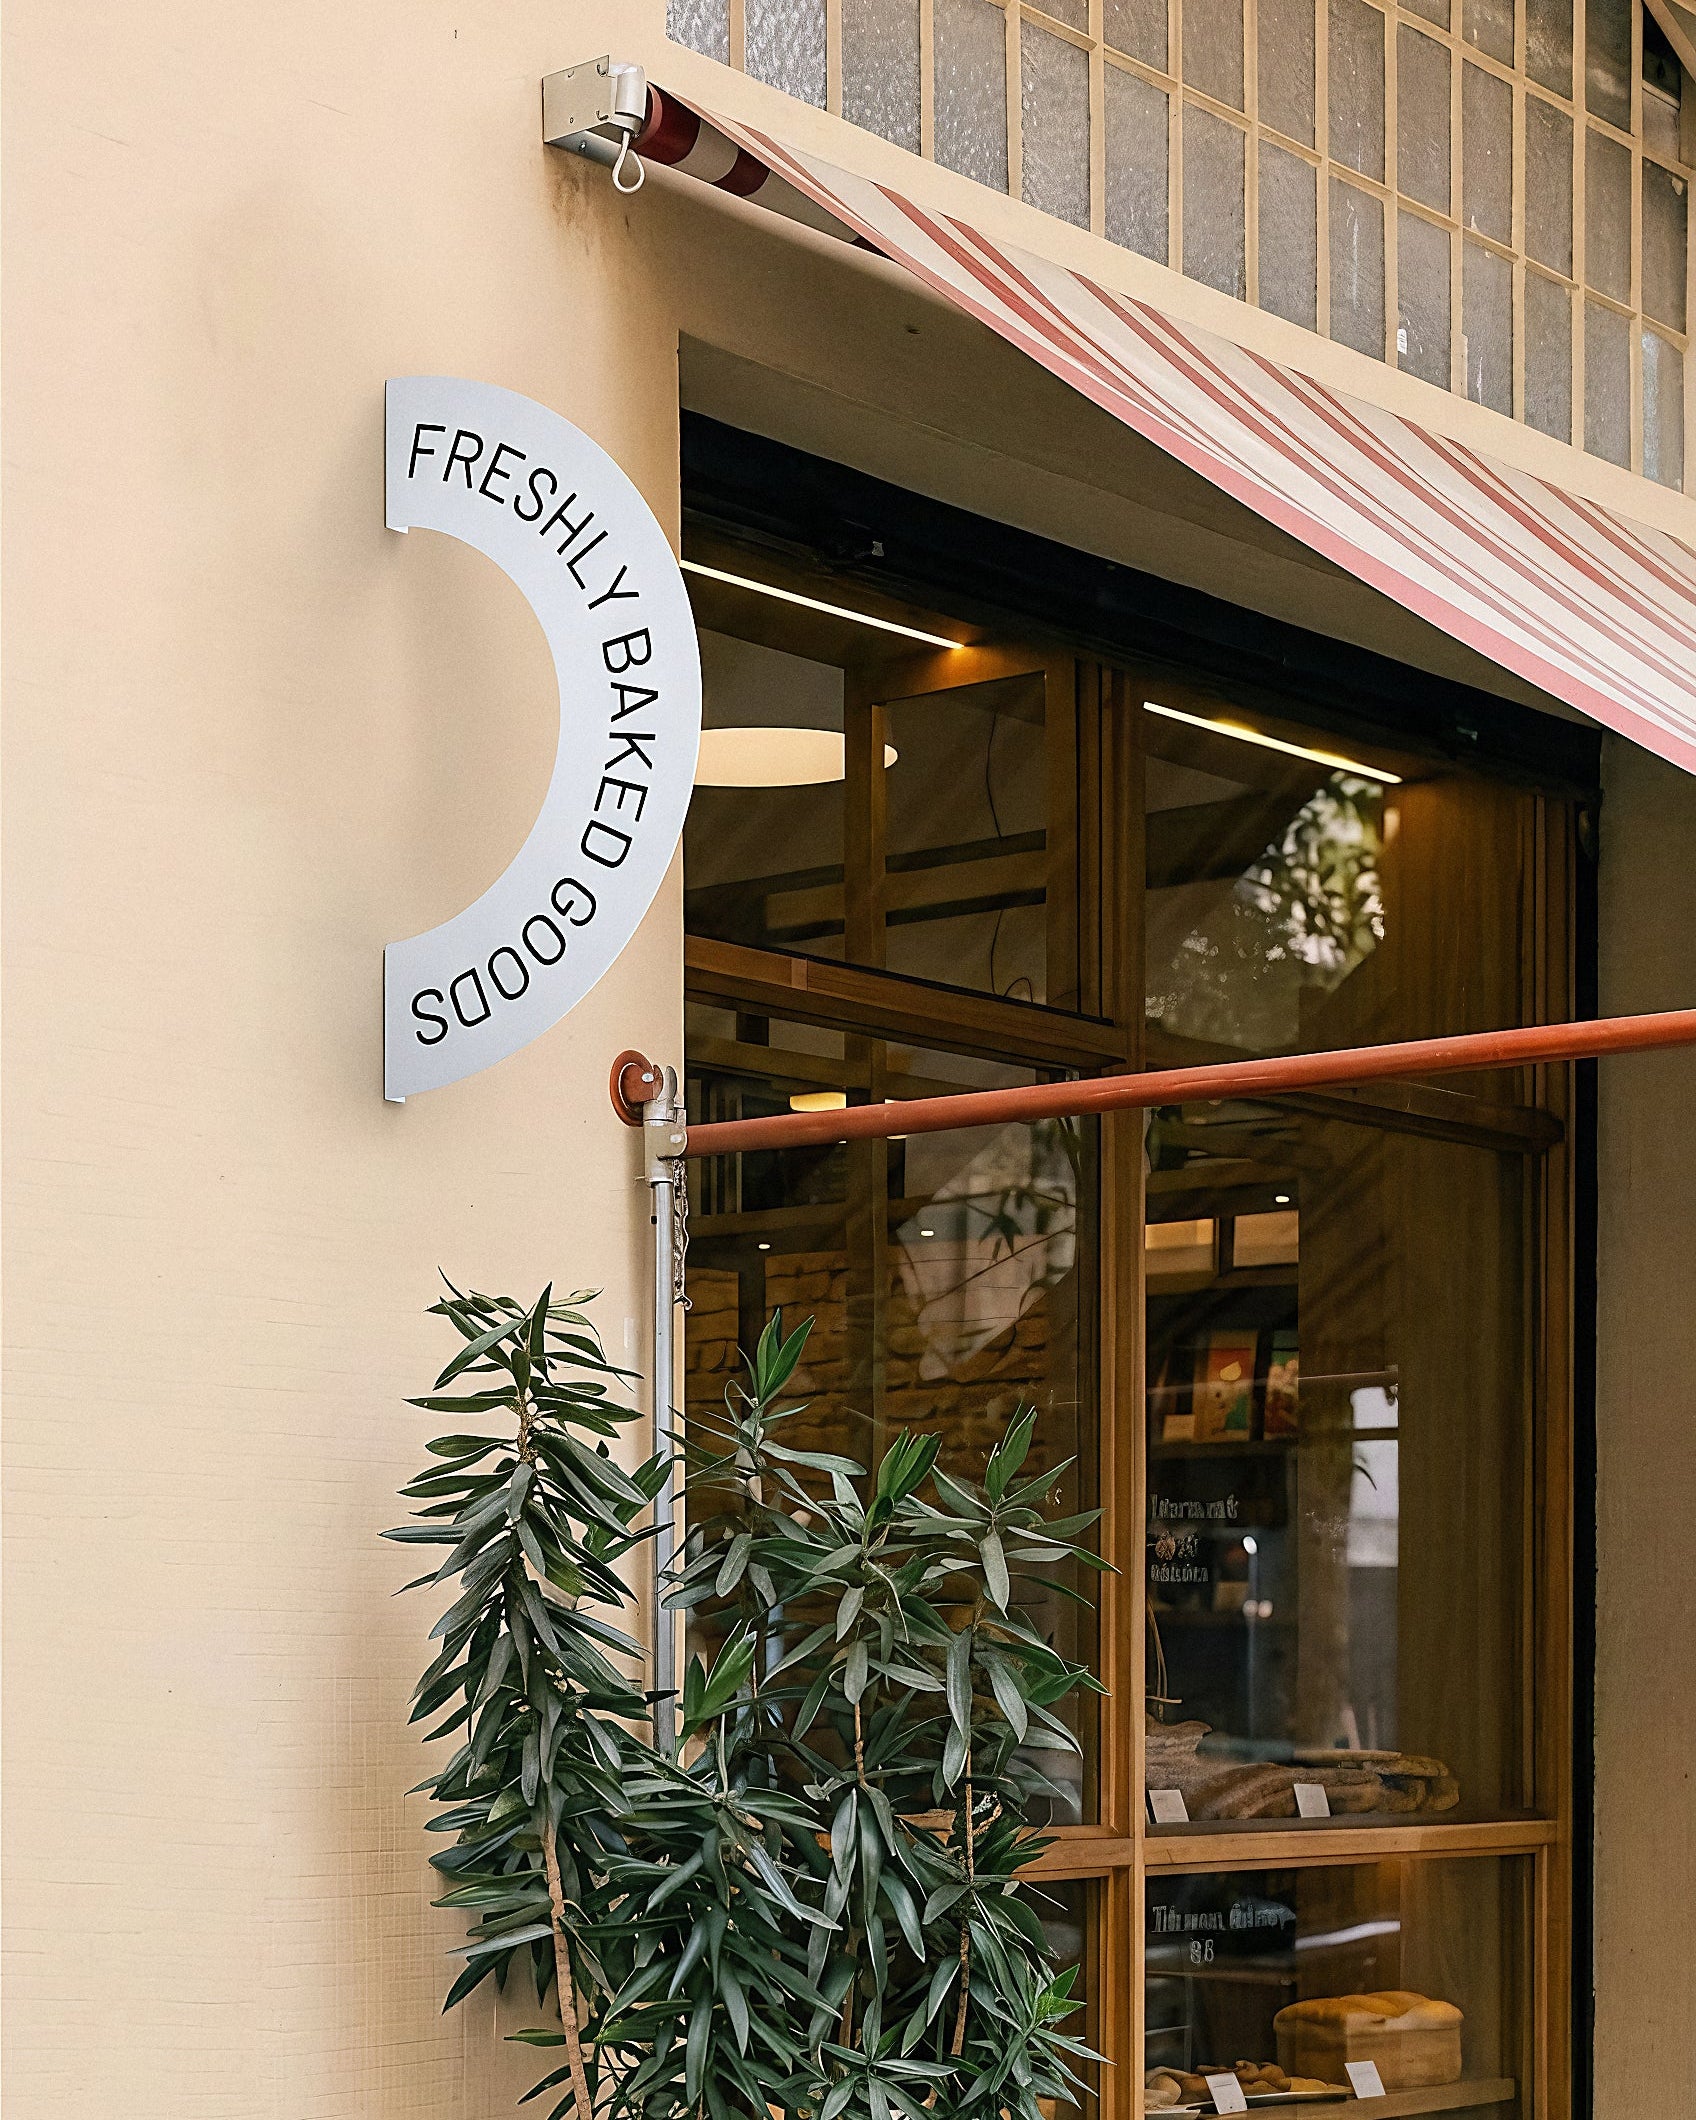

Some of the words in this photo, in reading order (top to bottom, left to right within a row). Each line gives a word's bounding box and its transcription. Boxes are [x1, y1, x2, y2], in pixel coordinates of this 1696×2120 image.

[407, 423, 640, 611] FRESHLY
[580, 627, 659, 869] BAKED
[411, 877, 597, 1046] GOODS
